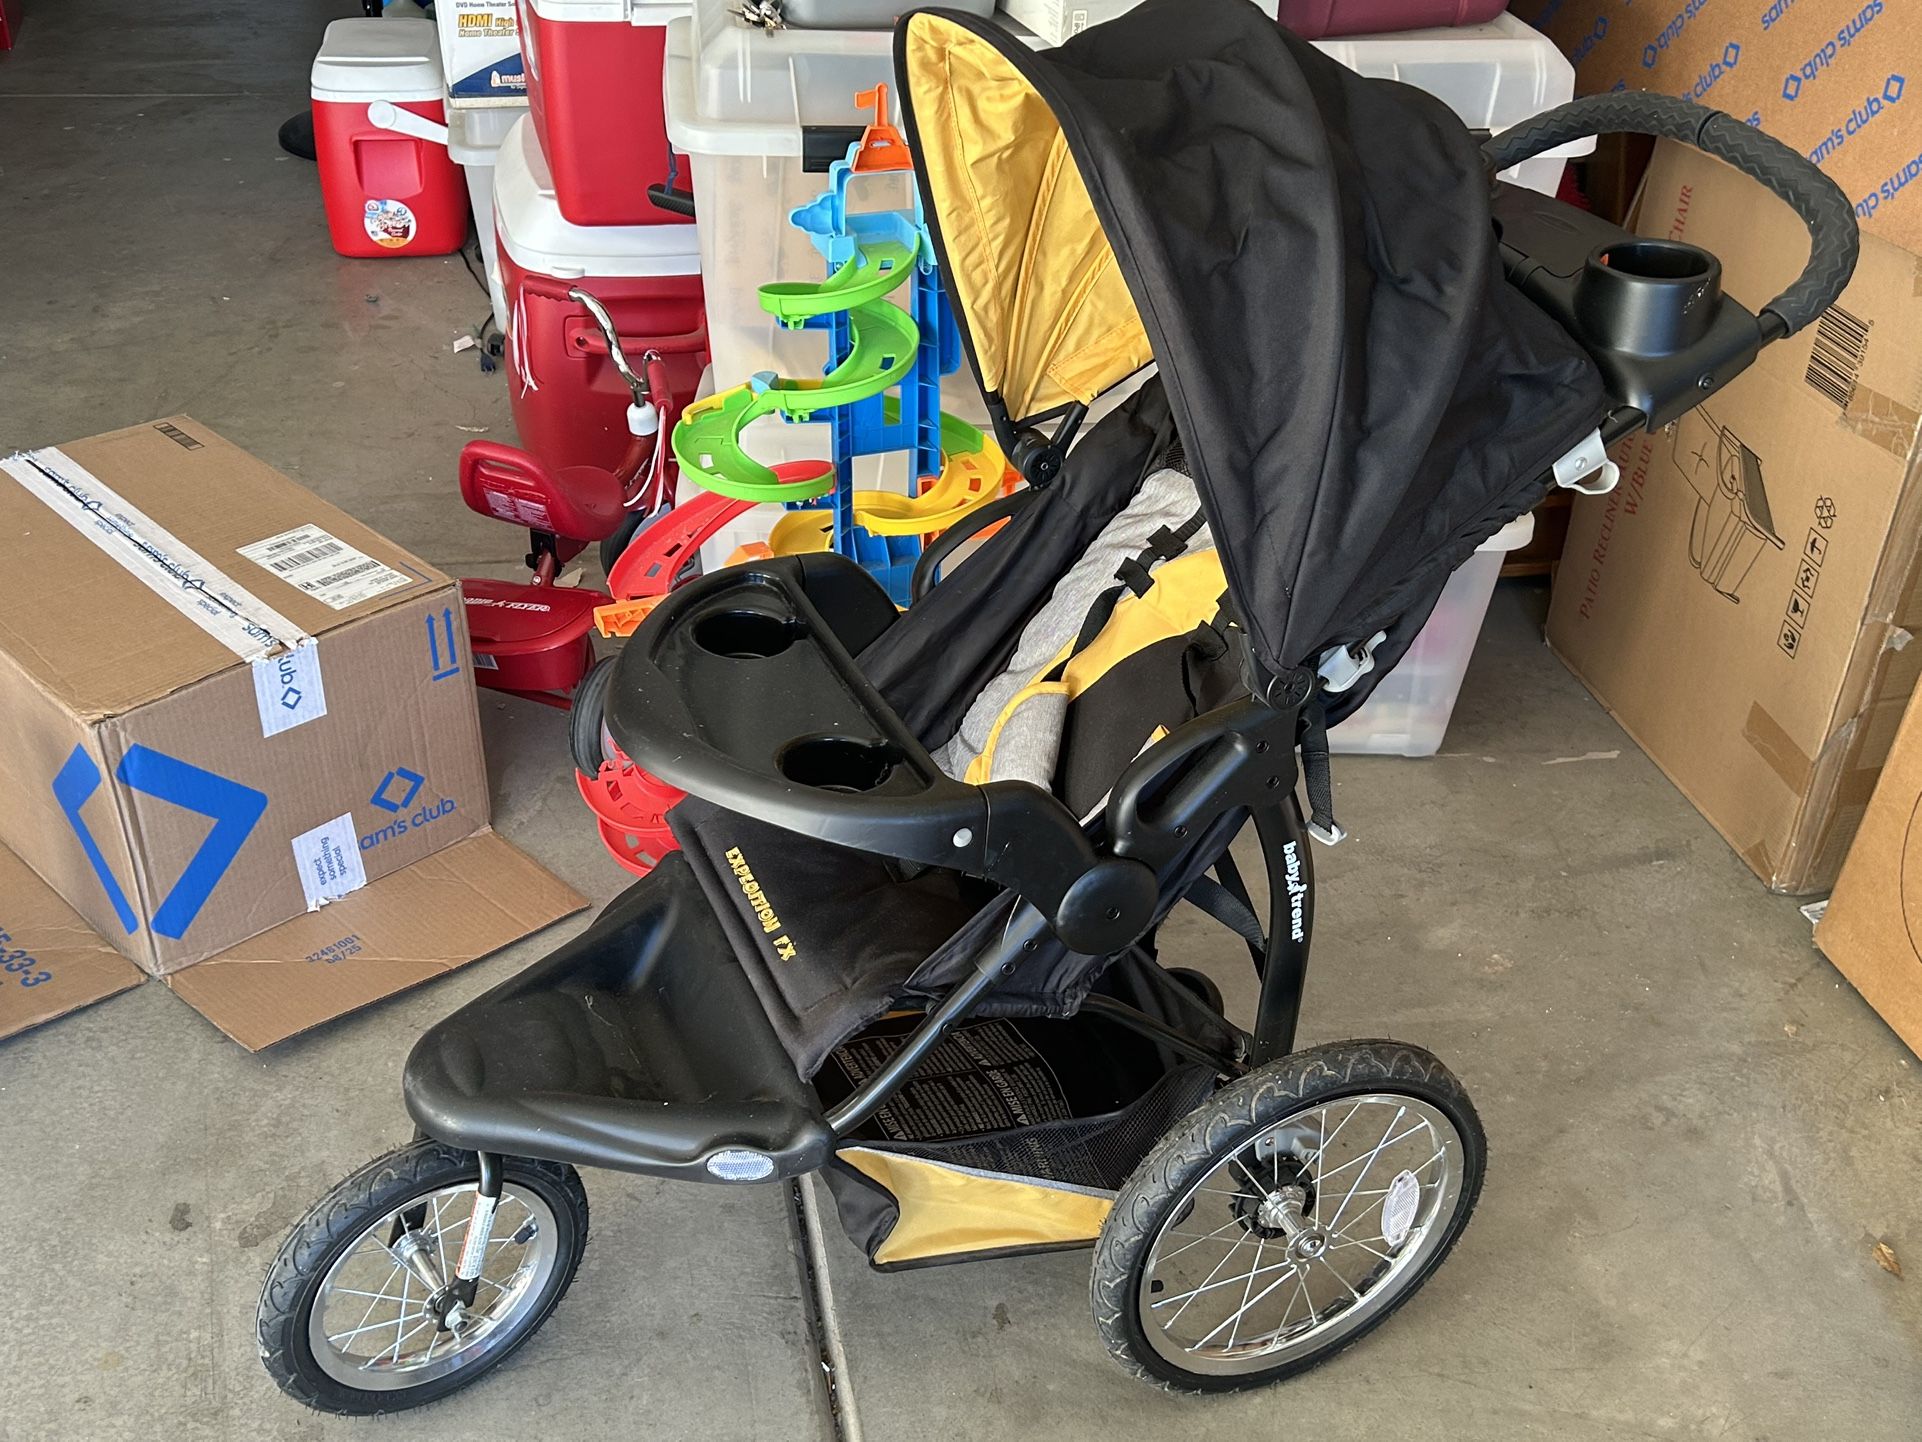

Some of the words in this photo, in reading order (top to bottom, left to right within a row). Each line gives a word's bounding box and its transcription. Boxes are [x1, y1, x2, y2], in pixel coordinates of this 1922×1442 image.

[458, 14, 492, 28] HDMI
[458, 29, 482, 37] Home
[483, 28, 514, 37] Theater
[1656, 13, 1684, 49] club
[1837, 0, 1884, 47] sam's
[1800, 41, 1836, 80] club
[1693, 63, 1722, 98] club
[1807, 128, 1844, 165] am's
[1845, 97, 1882, 136] club
[1855, 192, 1880, 218] clu
[1580, 568, 1601, 620] PATIO
[278, 654, 297, 685] lub
[359, 820, 408, 851] am's
[411, 798, 455, 828] club
[314, 857, 327, 886] expect
[320, 836, 337, 881] something
[333, 845, 347, 876] special
[1283, 841, 1301, 882] baby
[725, 847, 781, 933] EXPEDITION
[773, 935, 797, 961] FX
[1290, 893, 1304, 940] trend
